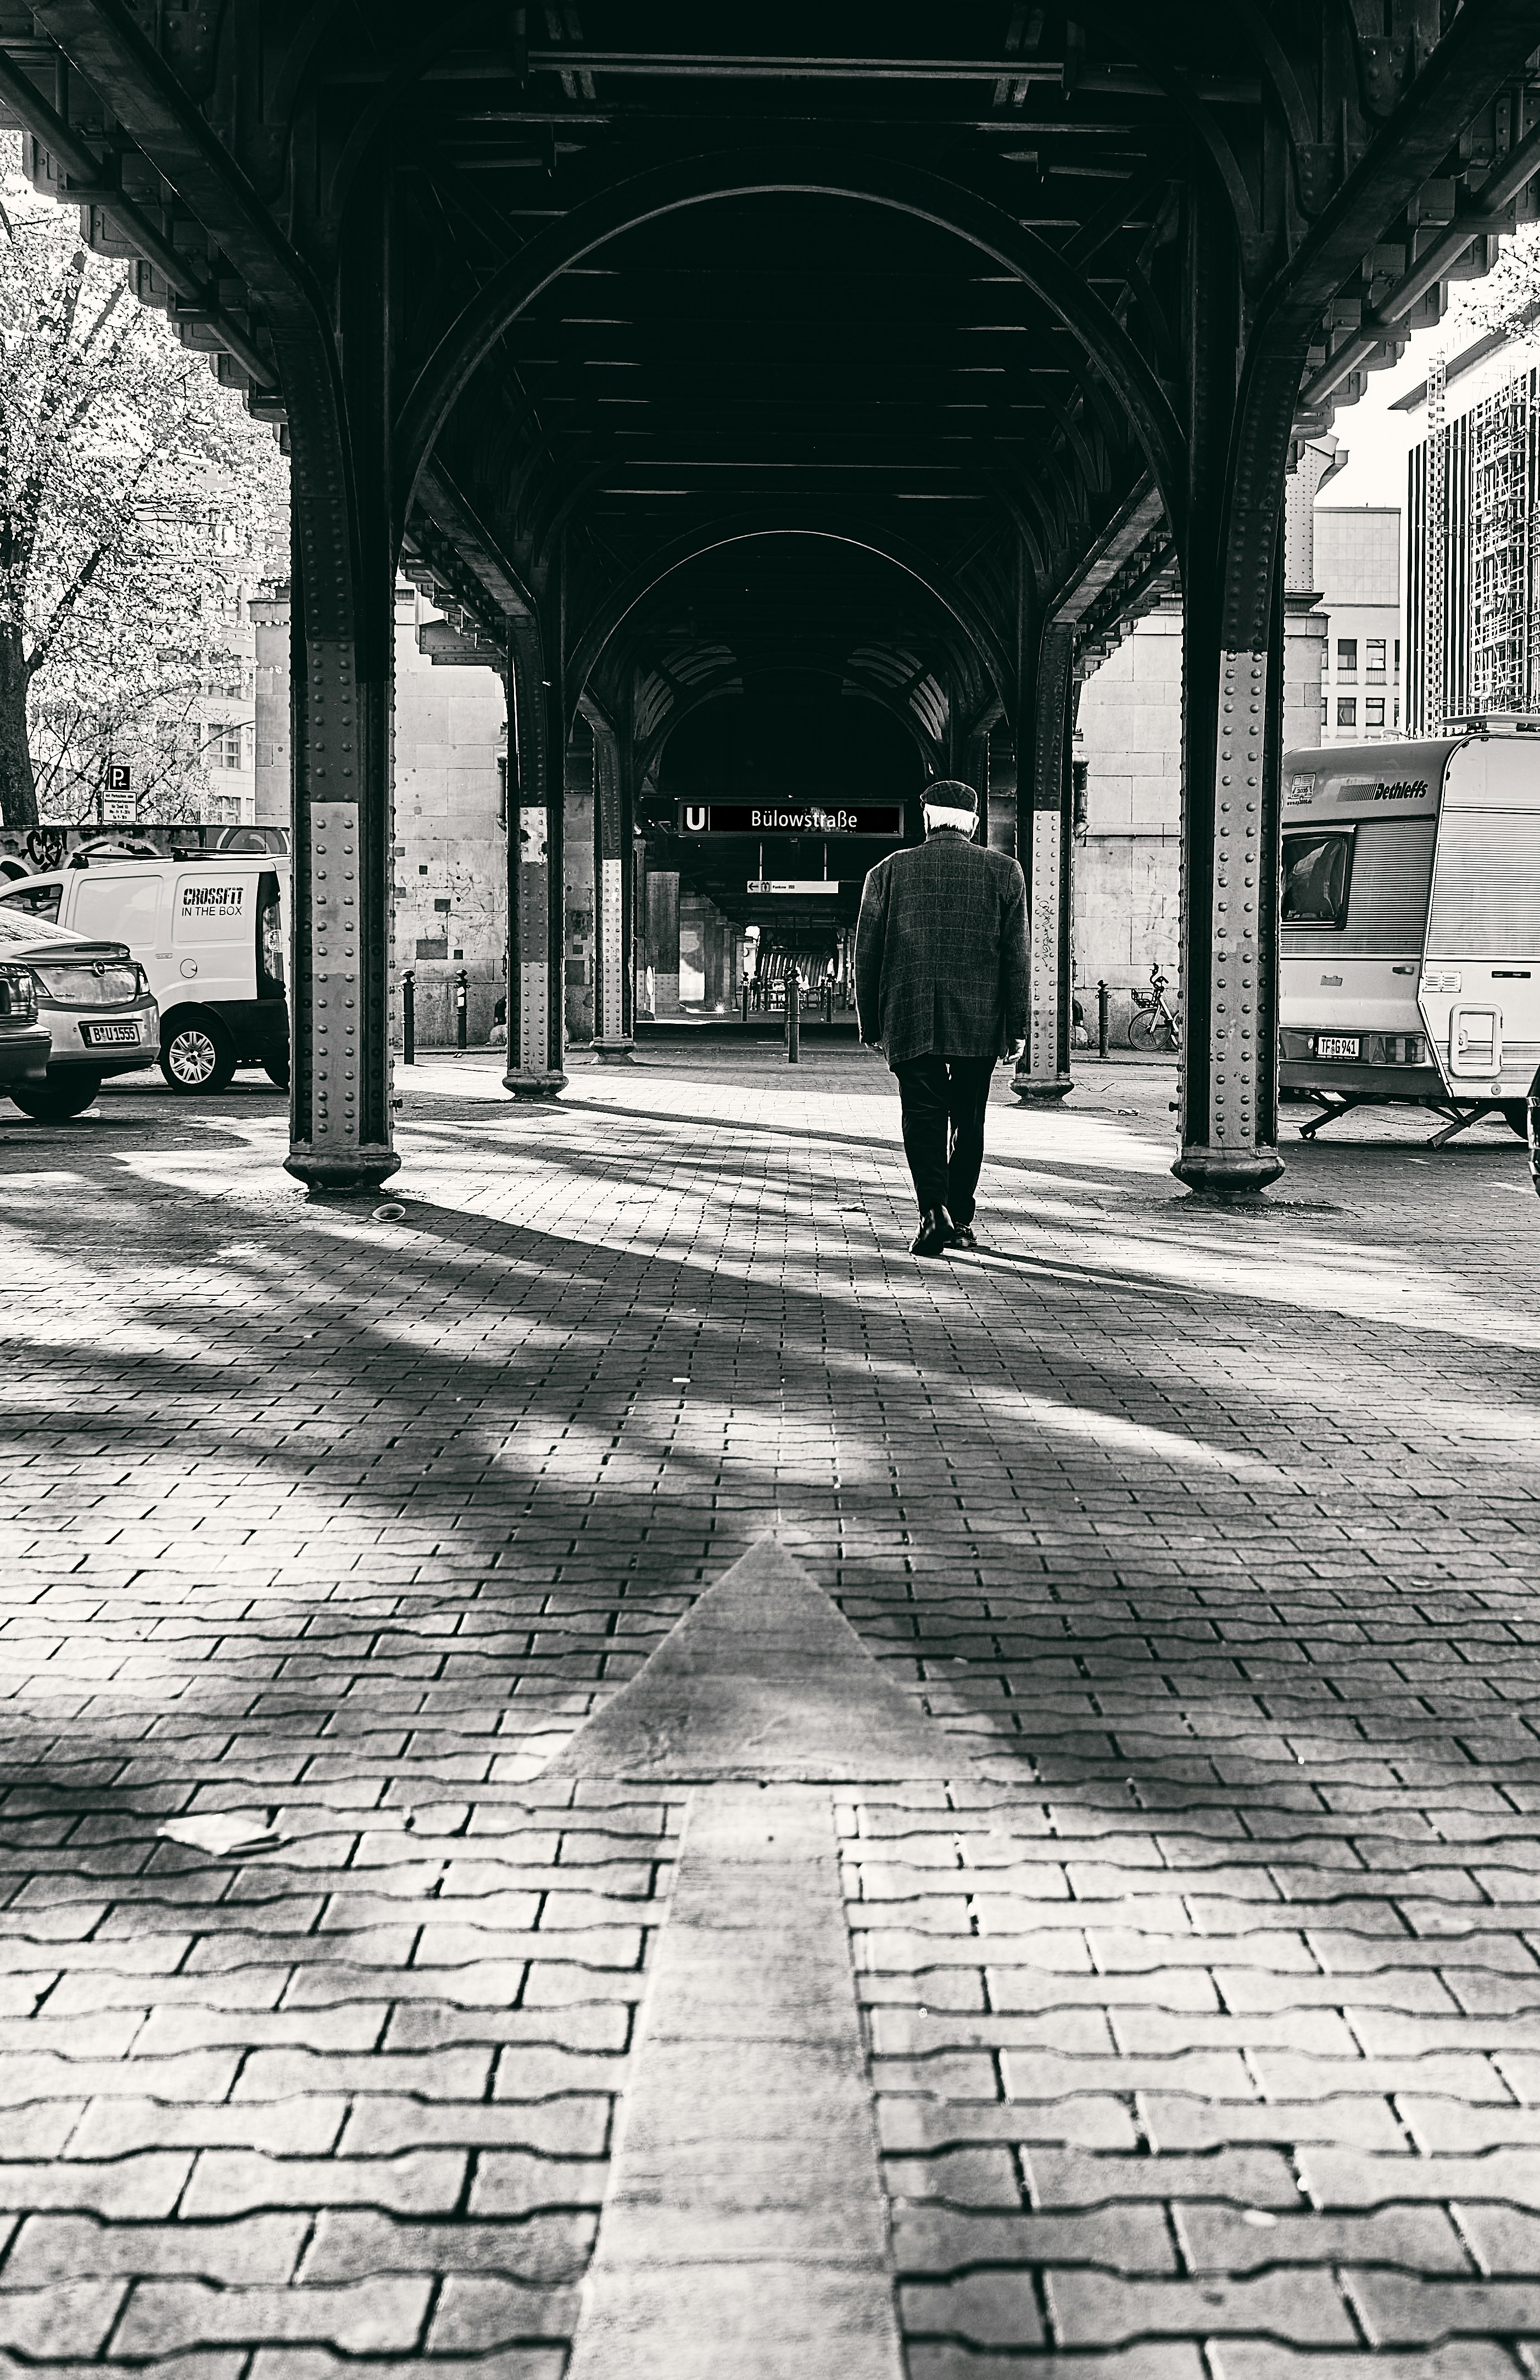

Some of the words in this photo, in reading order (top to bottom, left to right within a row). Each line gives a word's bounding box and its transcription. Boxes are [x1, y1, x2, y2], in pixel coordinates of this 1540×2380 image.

[113, 768, 124, 787] P
[1374, 780, 1429, 800] Dethleffs
[687, 807, 706, 831] U
[751, 810, 857, 828] Bülowstraße
[183, 887, 243, 905] CROSSFIT
[182, 907, 192, 916] IN
[195, 906, 216, 916] THE
[219, 906, 242, 916] BOX
